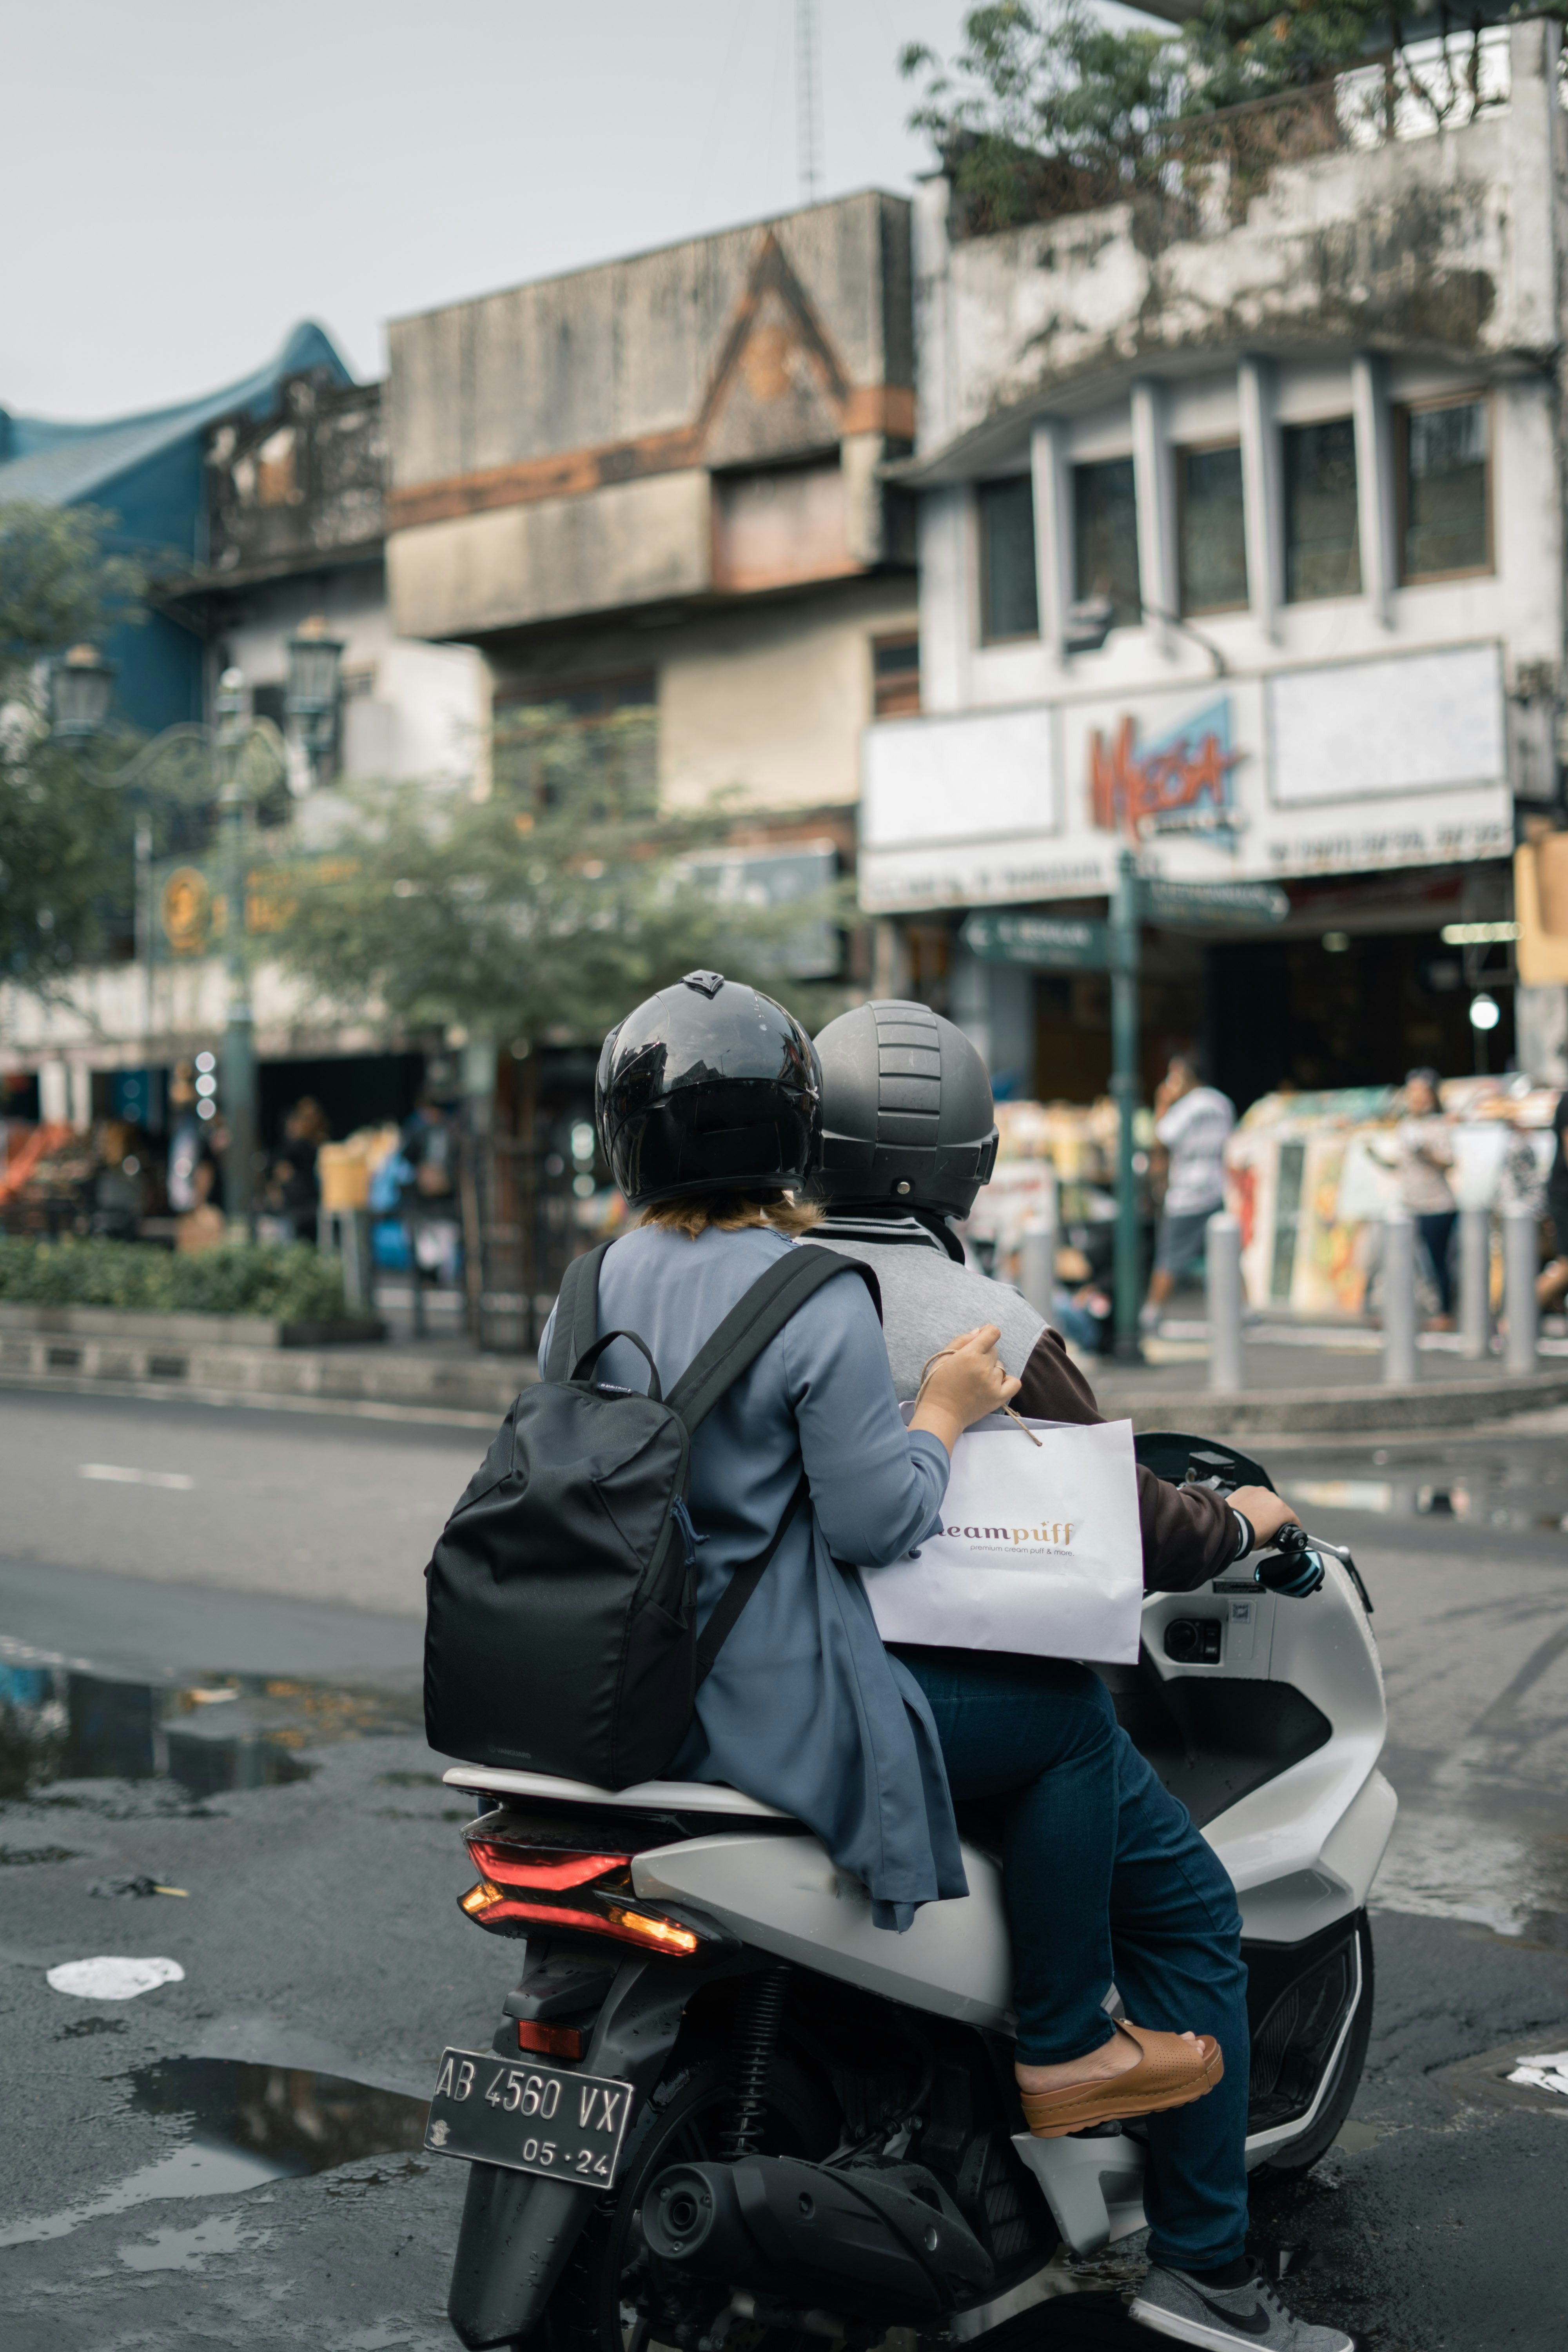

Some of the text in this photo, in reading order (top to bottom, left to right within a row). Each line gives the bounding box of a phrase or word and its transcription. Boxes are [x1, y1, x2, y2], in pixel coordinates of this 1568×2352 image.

[496, 1748, 531, 1759] VANGUARD
[434, 2057, 620, 2133] AB 4560 VX
